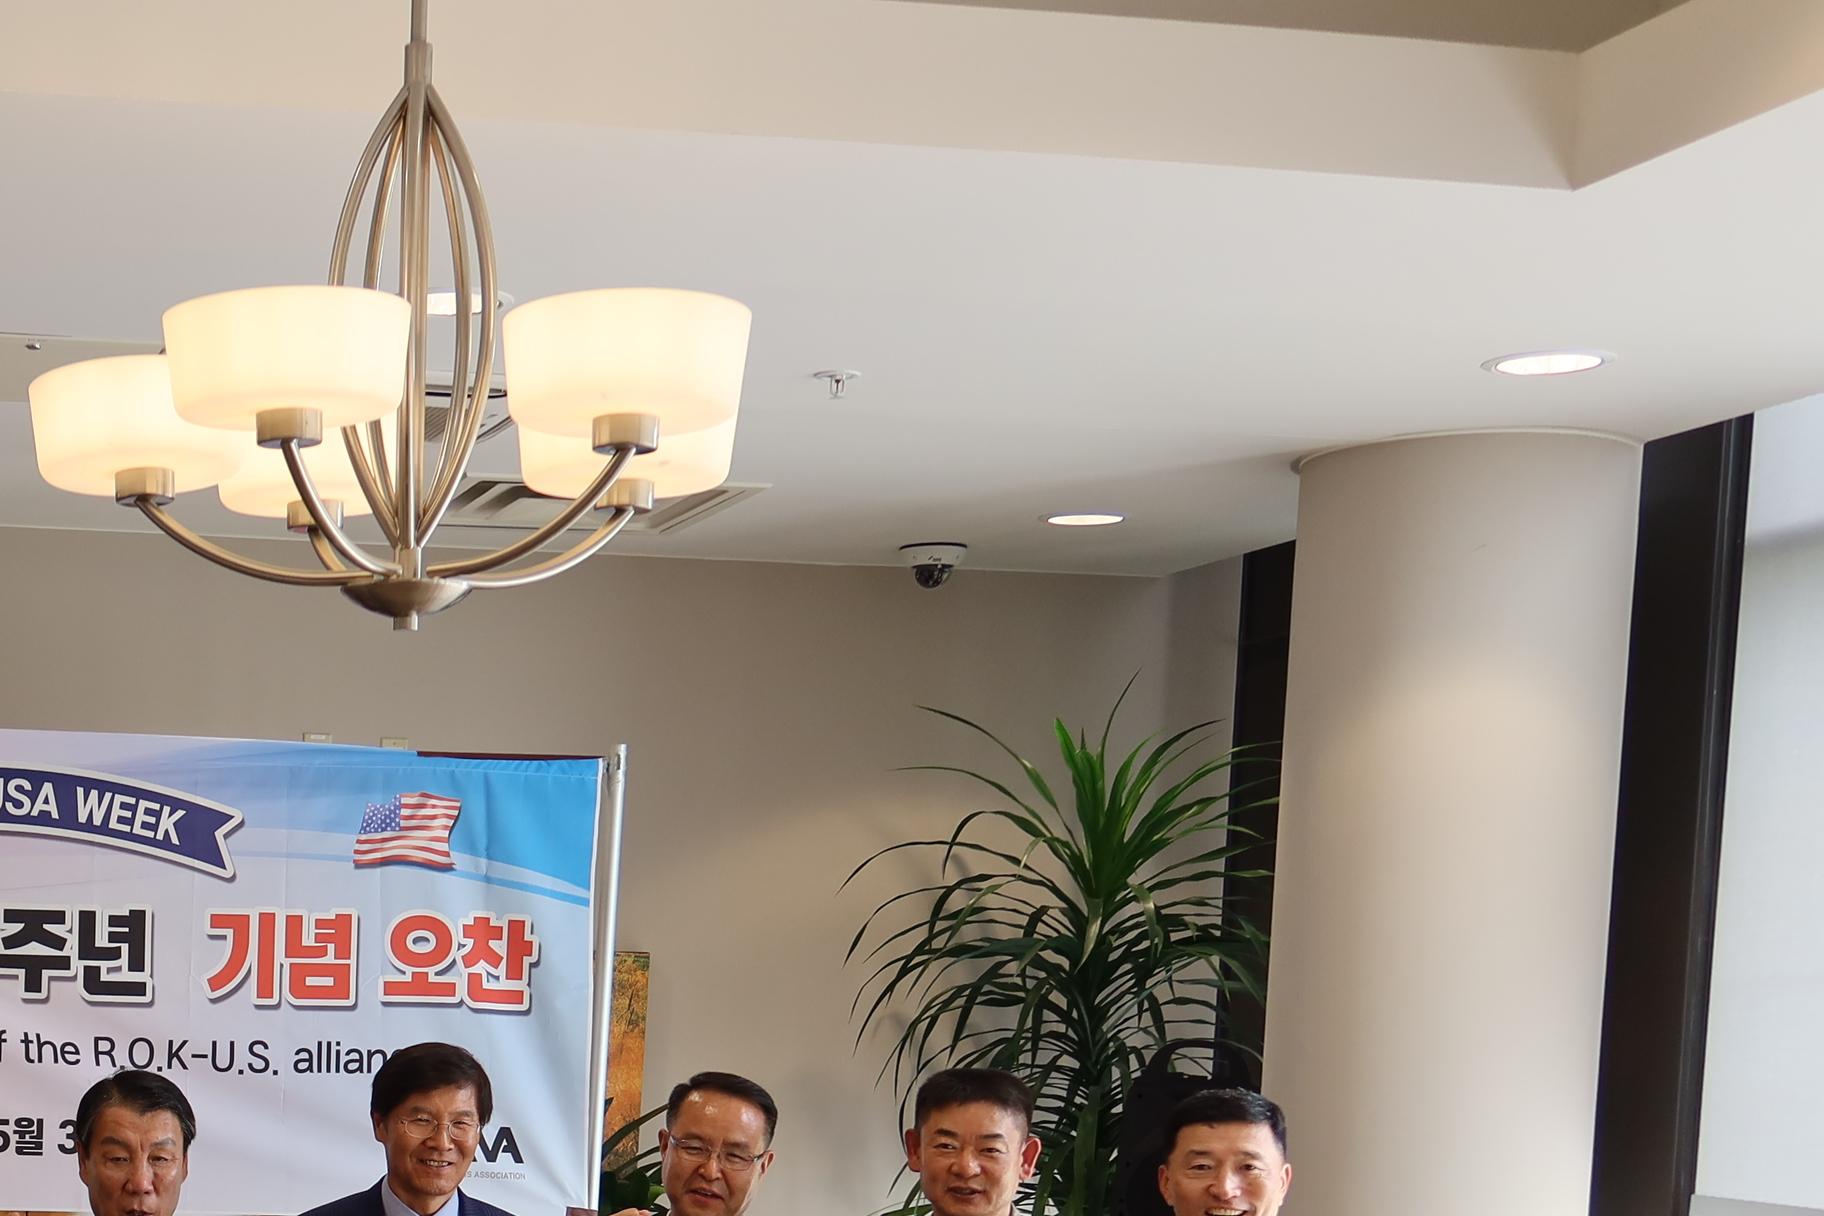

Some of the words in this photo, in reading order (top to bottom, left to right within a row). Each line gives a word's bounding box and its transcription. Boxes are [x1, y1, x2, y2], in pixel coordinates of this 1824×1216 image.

[76, 786, 187, 846] WEEK
[205, 909, 354, 1002] 기념
[382, 913, 533, 1006] 오찬
[20, 1031, 81, 1065] the
[293, 1041, 388, 1074] allian
